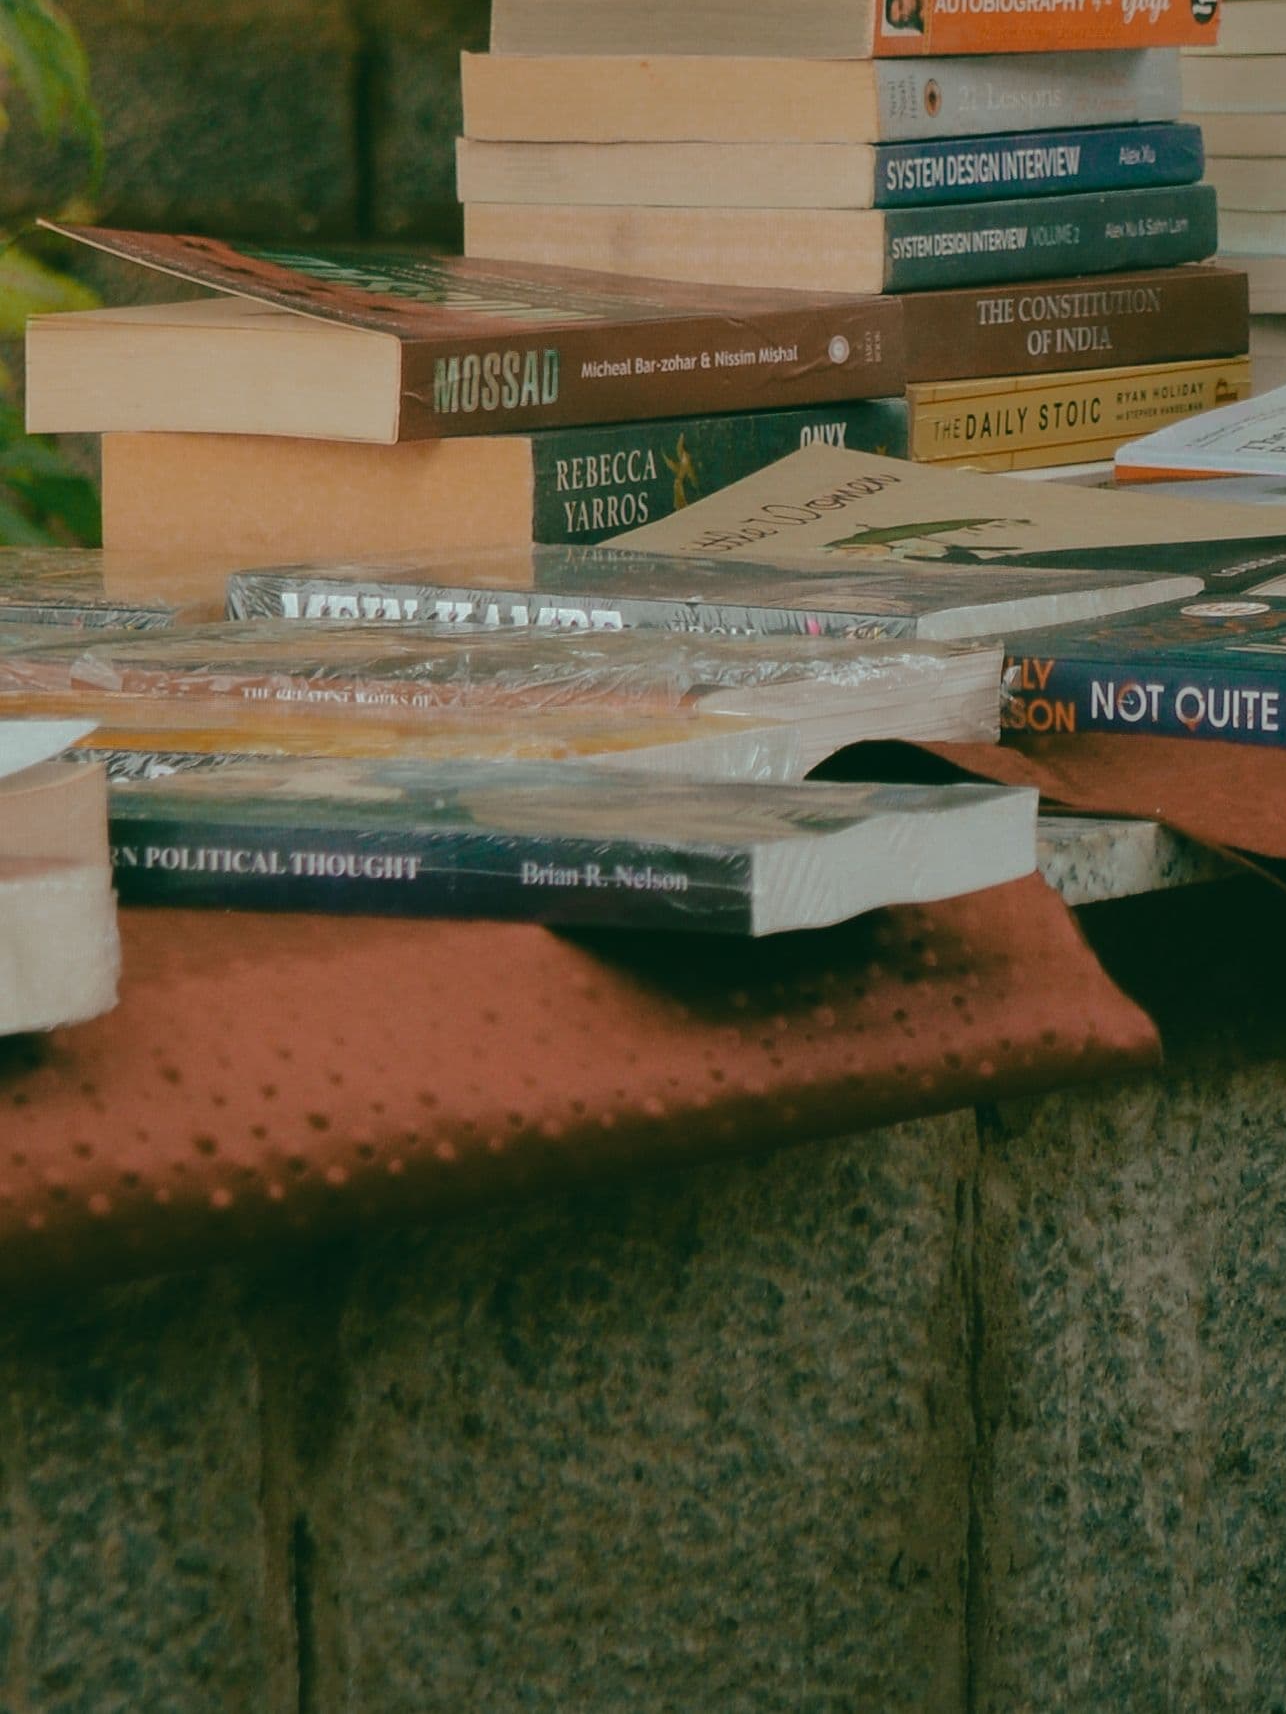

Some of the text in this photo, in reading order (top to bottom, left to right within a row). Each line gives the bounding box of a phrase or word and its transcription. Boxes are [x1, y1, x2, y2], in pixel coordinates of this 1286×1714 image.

[986, 84, 1062, 112] Lessons
[886, 145, 1082, 191] SYSTEM DESIGN INTERVIEW
[890, 223, 1081, 260] SYSTEM DESIGN INTERVIEW VOLUME 2
[976, 286, 1164, 326] THE CONSTITUTION
[1027, 325, 1113, 357] OF INDIA
[433, 347, 561, 414] MOSSAD
[580, 345, 798, 379] Micheal Bar-zohar & Nissim Mishal
[1115, 388, 1148, 405] RYAN
[1152, 381, 1205, 400] HOLIDAY
[933, 396, 1102, 442] THE DAILY STOIC
[556, 449, 658, 492] REBECCA
[564, 492, 649, 534] YARROS
[241, 686, 270, 699] THE
[1090, 680, 1165, 723] NOT
[1175, 686, 1280, 733] QUITE
[144, 848, 286, 875] POLITICAL
[289, 852, 422, 880] THOUGHT
[520, 861, 690, 891] Brian R. Nelson
